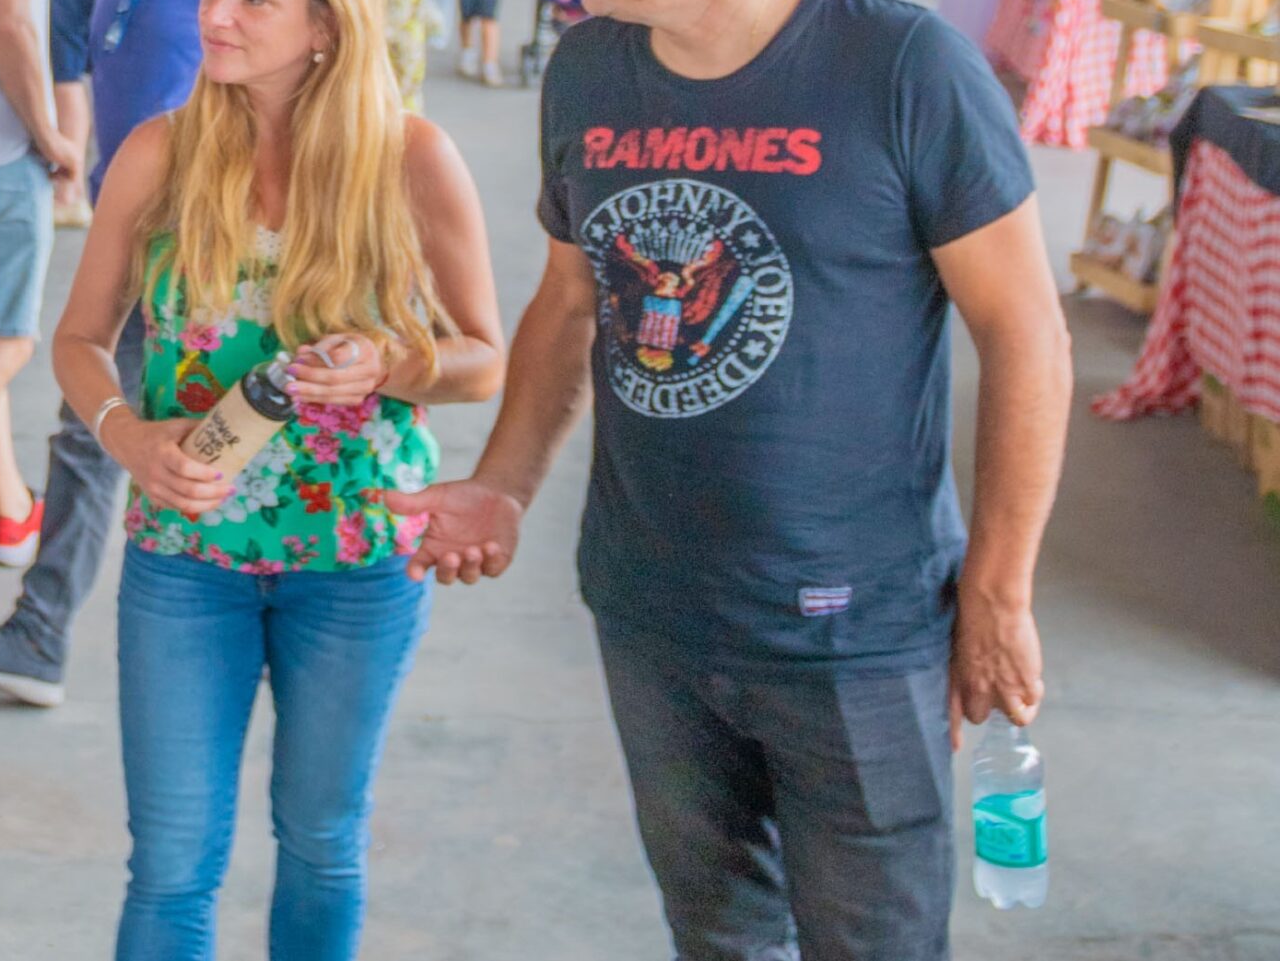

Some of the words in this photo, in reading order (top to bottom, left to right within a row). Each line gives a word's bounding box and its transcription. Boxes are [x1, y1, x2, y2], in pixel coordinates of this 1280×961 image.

[583, 127, 822, 175] RAMONES
[604, 183, 756, 235] JOHNNY
[745, 248, 789, 345] JOEY
